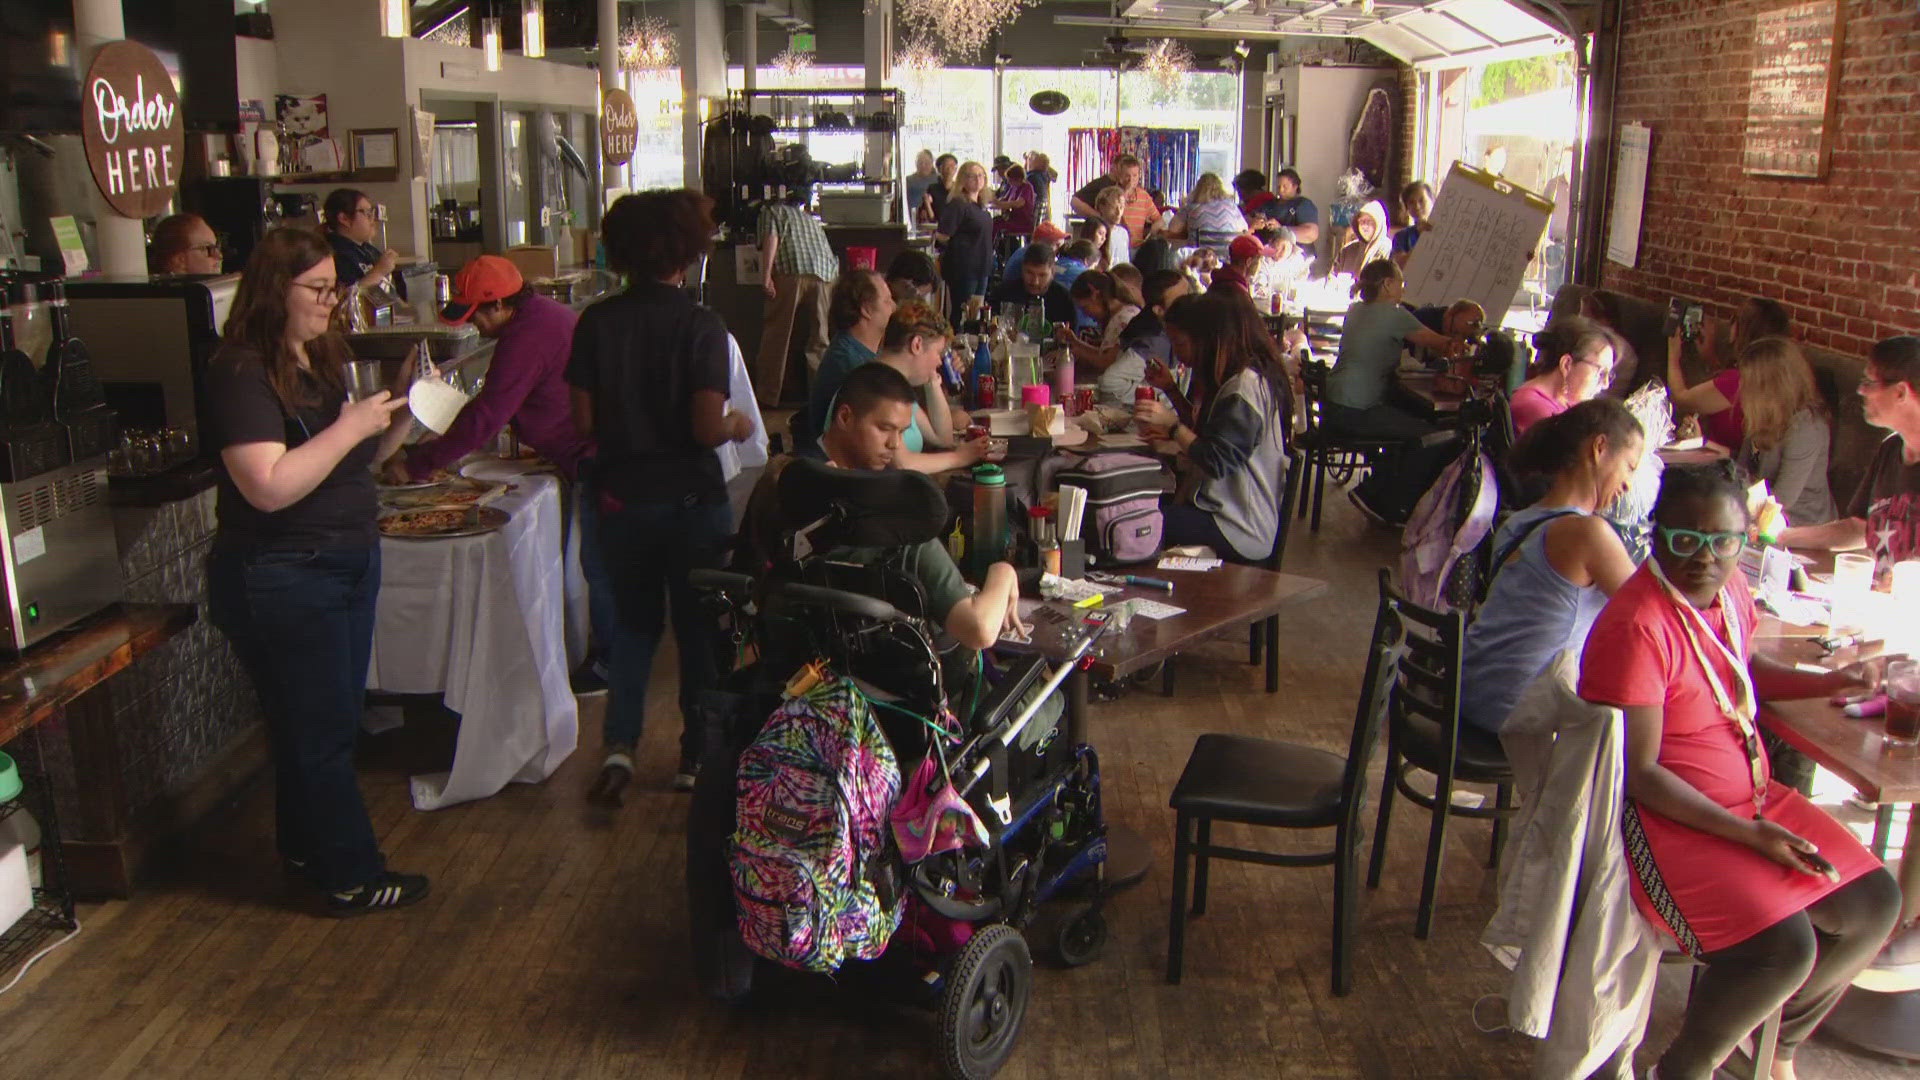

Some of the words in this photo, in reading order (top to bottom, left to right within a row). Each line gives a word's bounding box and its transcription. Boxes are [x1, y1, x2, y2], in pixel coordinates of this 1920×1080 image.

[93, 74, 174, 144] Order
[606, 104, 636, 133] Order
[608, 134, 634, 155] HERE
[106, 144, 175, 196] HERE
